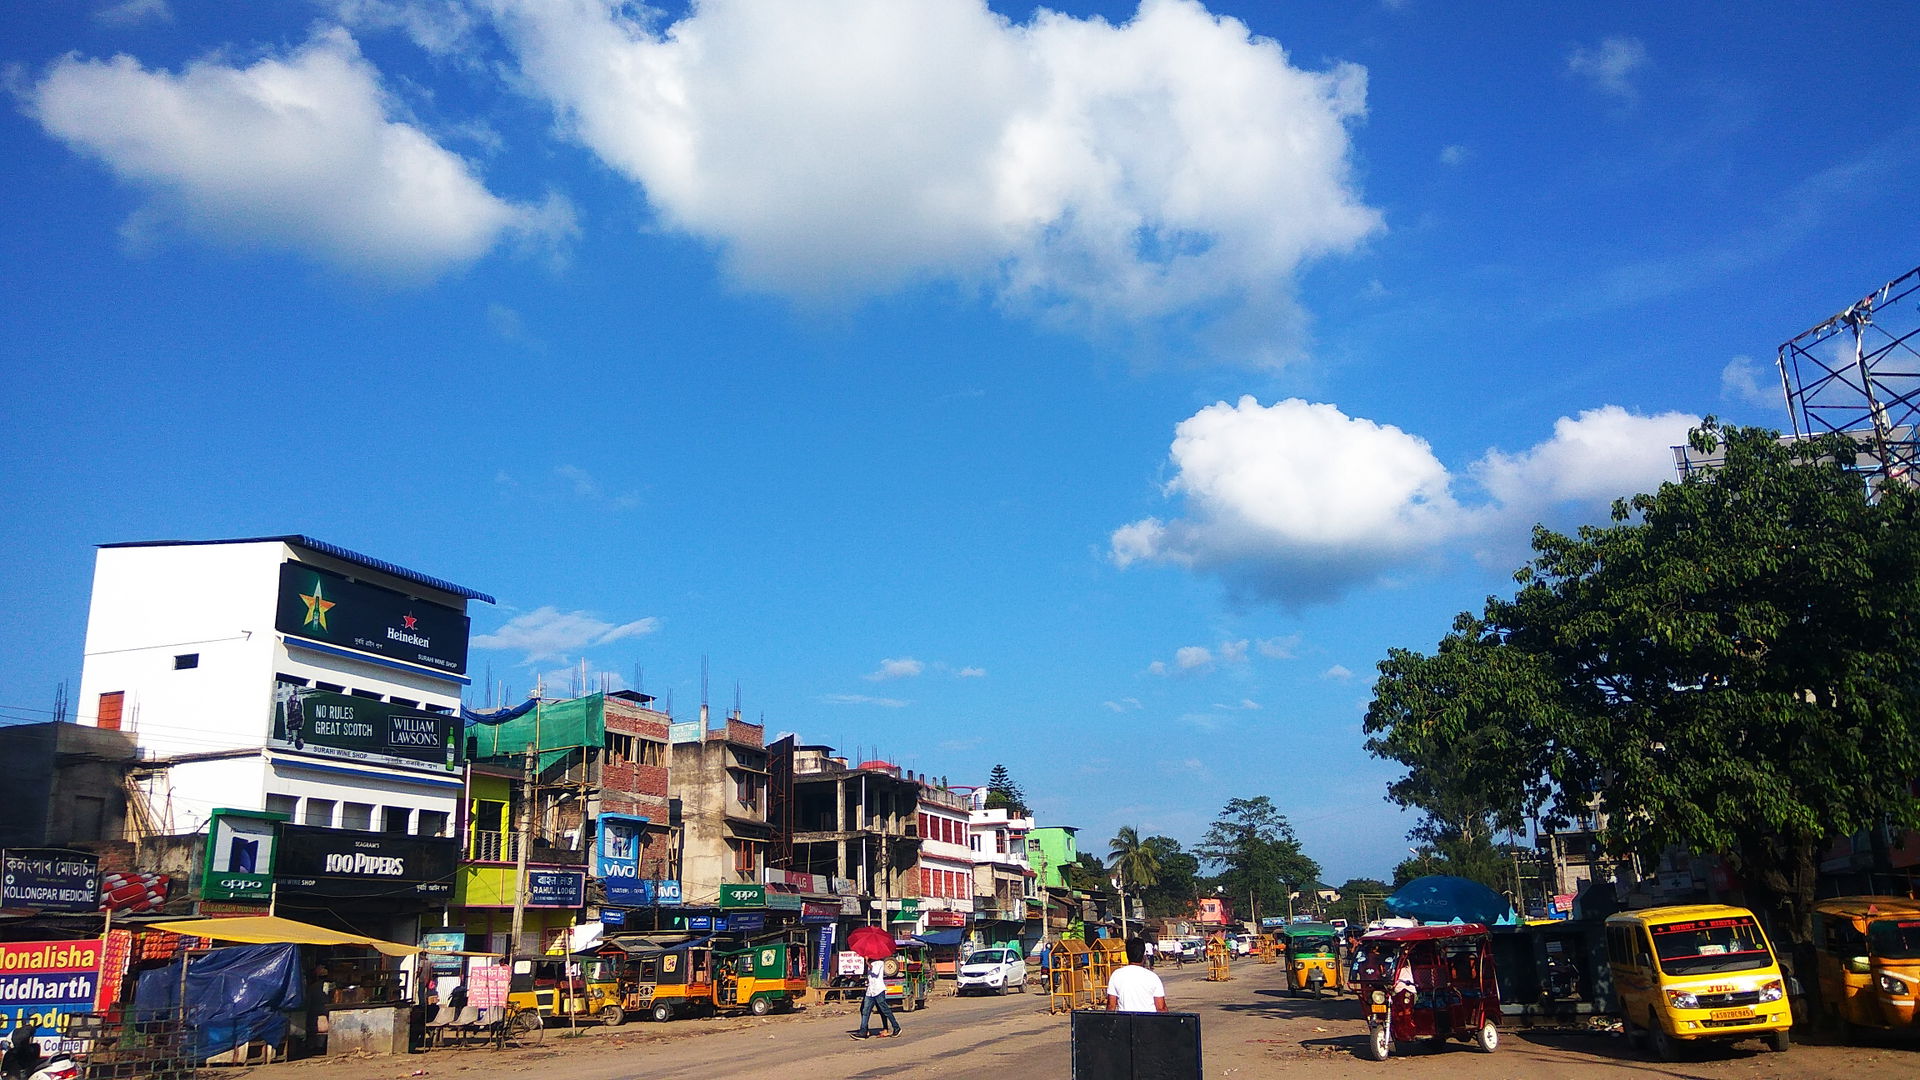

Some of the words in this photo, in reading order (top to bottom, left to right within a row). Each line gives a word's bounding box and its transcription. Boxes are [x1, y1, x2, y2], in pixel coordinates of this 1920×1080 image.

[387, 627, 429, 648] Heineken
[445, 661, 458, 669] SHOP
[315, 704, 327, 718] NO
[329, 706, 354, 720] RULES
[315, 721, 341, 736] GREAT
[343, 722, 373, 737] SCOTCH
[393, 718, 435, 732] WILLIAM
[313, 745, 336, 755] SURAHI
[336, 750, 351, 758] WINE
[352, 752, 368, 760] SHOP
[325, 853, 354, 873] 100
[354, 852, 404, 876] PIPERS
[221, 879, 262, 889] oppo
[799, 877, 807, 889] LG
[4, 886, 58, 900] KOLLONGPAR
[59, 888, 95, 902] MEDICINE
[533, 886, 555, 894] RAHUL
[557, 887, 576, 895] LODGE
[730, 890, 758, 900] oppo
